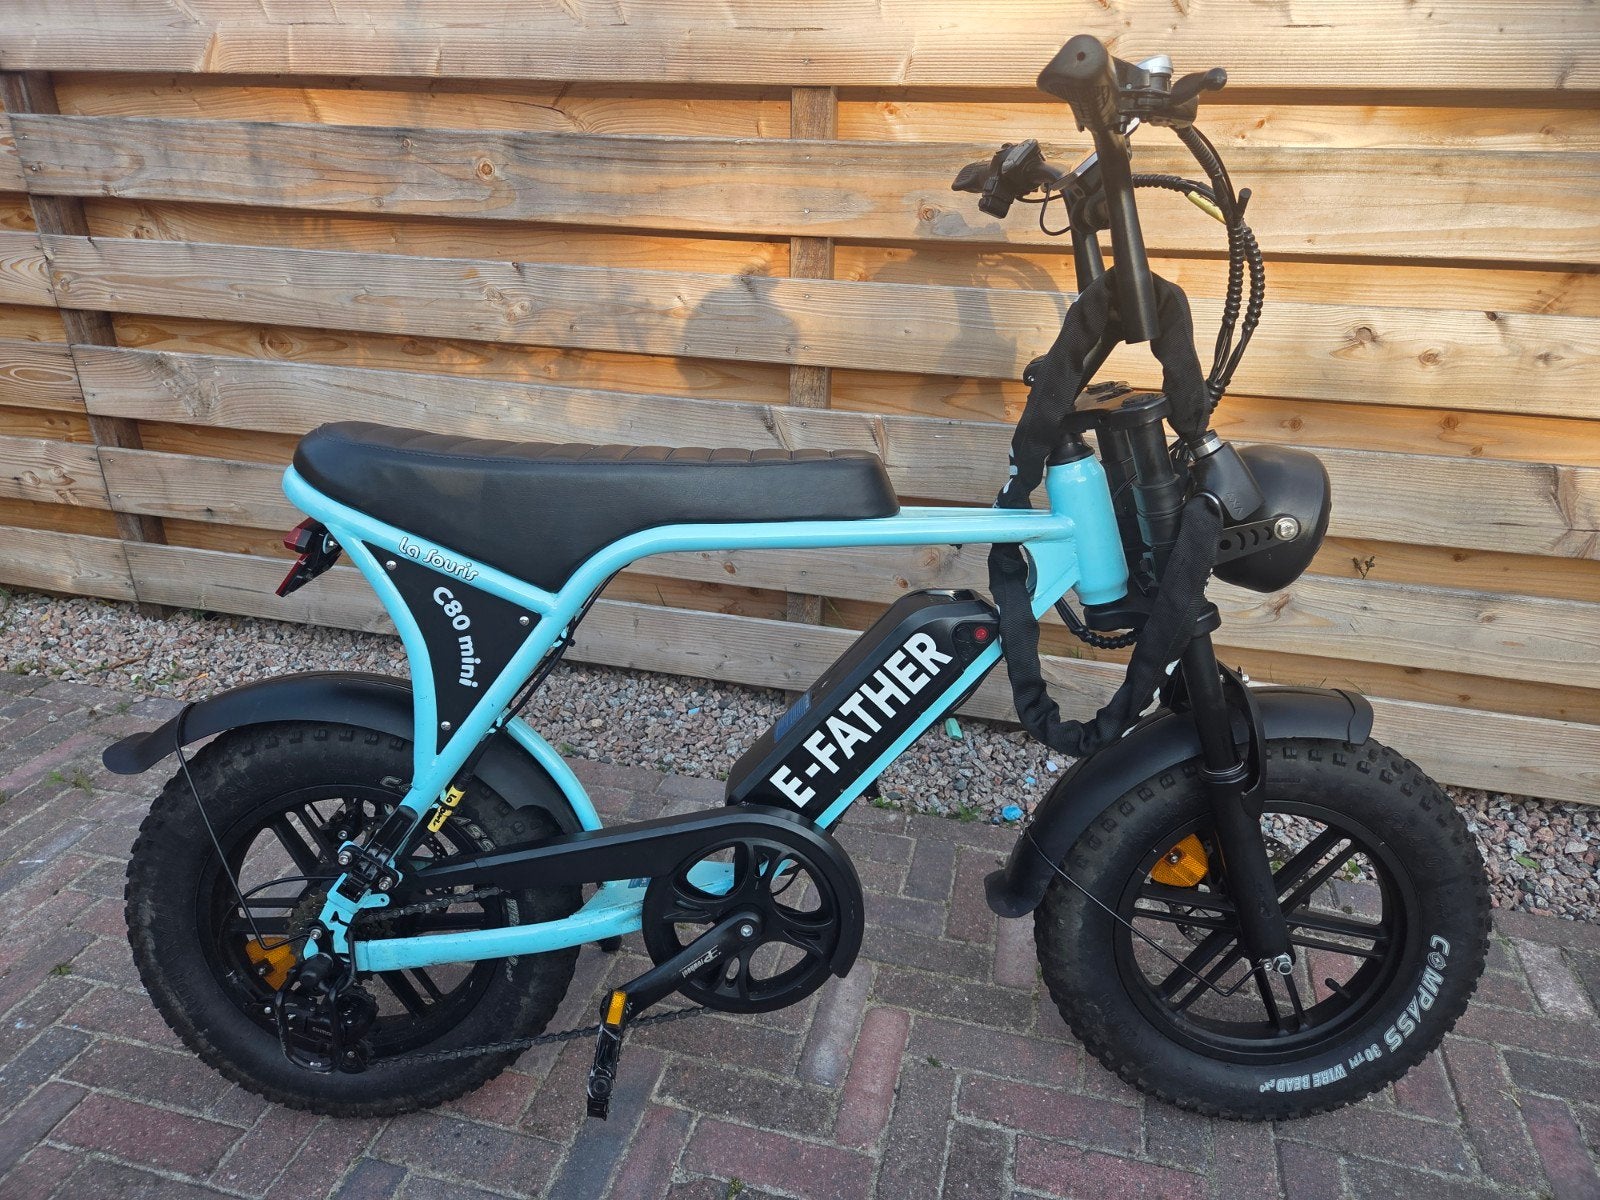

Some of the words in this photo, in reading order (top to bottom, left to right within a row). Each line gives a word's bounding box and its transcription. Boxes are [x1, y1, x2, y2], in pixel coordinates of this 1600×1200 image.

[423, 548, 479, 582] Souris
[433, 586, 471, 631] C80
[458, 635, 482, 688] mini
[769, 632, 953, 808] E-FATHER
[1383, 934, 1451, 1053] COMPASS
[1363, 1043, 1383, 1062] 30
[1275, 1074, 1311, 1093] BEAD
[1312, 1063, 1348, 1088] WIRE
